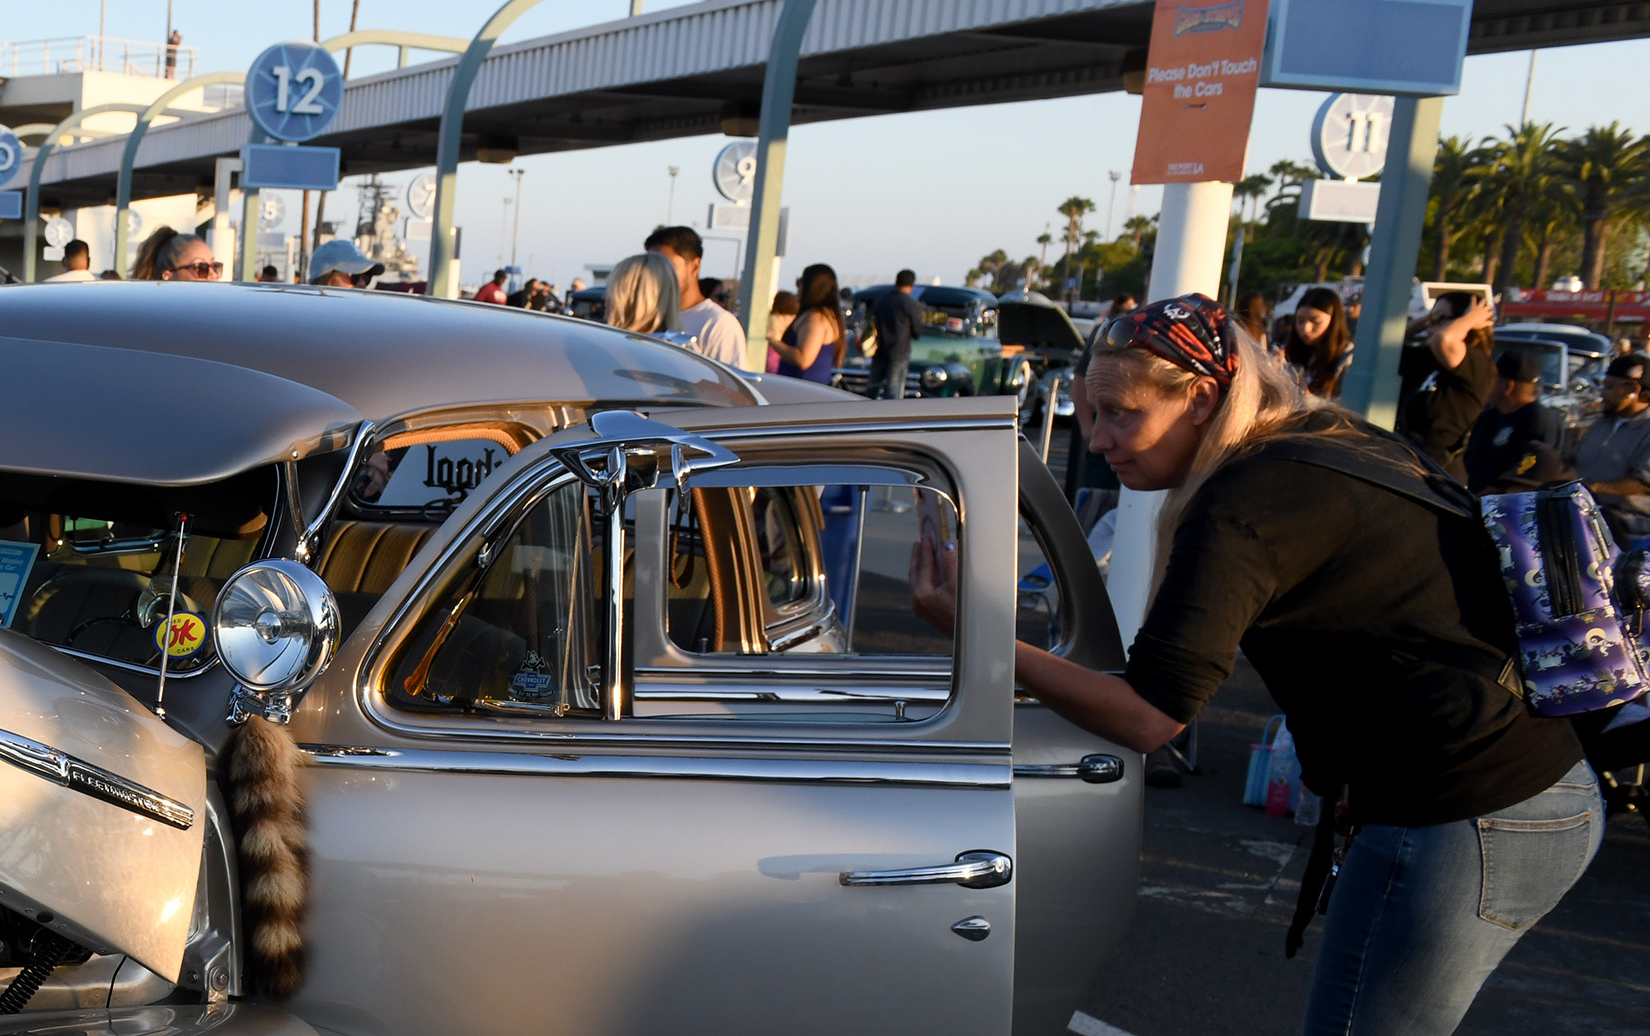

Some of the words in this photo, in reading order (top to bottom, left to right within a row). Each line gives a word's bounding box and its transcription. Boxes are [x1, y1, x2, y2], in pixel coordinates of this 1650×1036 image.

[1148, 67, 1186, 82] Please
[1188, 61, 1219, 79] Don't
[1221, 57, 1257, 75] Touch
[273, 66, 325, 114] 12
[1174, 84, 1192, 98] the
[1195, 81, 1223, 97] Cars
[1348, 110, 1384, 153] 11
[737, 156, 757, 185] 9
[1193, 162, 1204, 175] LA
[263, 200, 277, 220] 5
[2, 557, 25, 566] Display
[162, 619, 198, 649] OK
